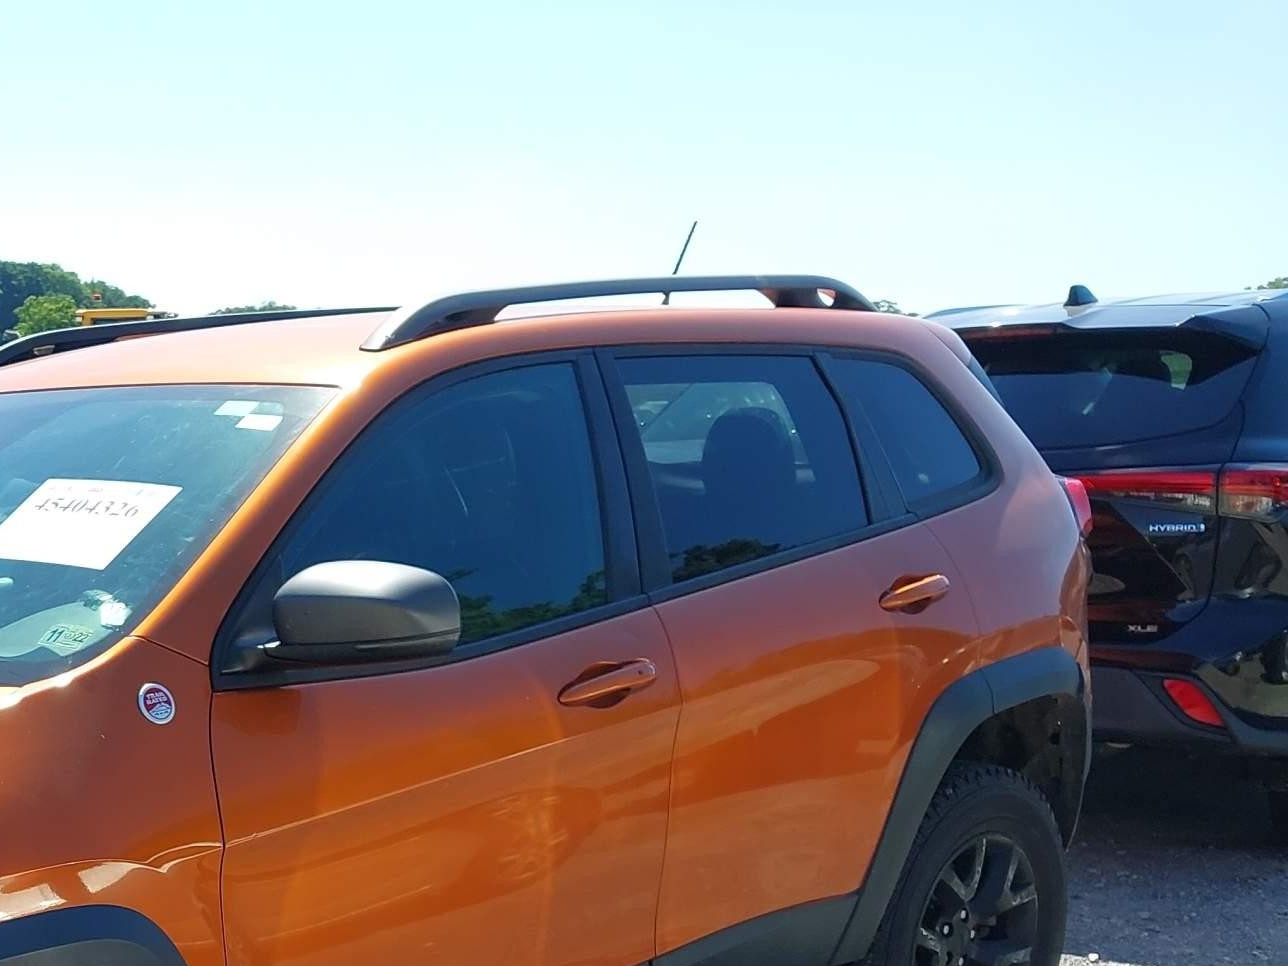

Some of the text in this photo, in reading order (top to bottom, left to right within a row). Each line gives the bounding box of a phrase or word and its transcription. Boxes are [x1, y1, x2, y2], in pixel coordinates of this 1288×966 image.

[35, 498, 139, 518] 45404326
[1149, 523, 1197, 533] HYBRID
[1127, 624, 1158, 633] XLE
[47, 628, 66, 643] 11
